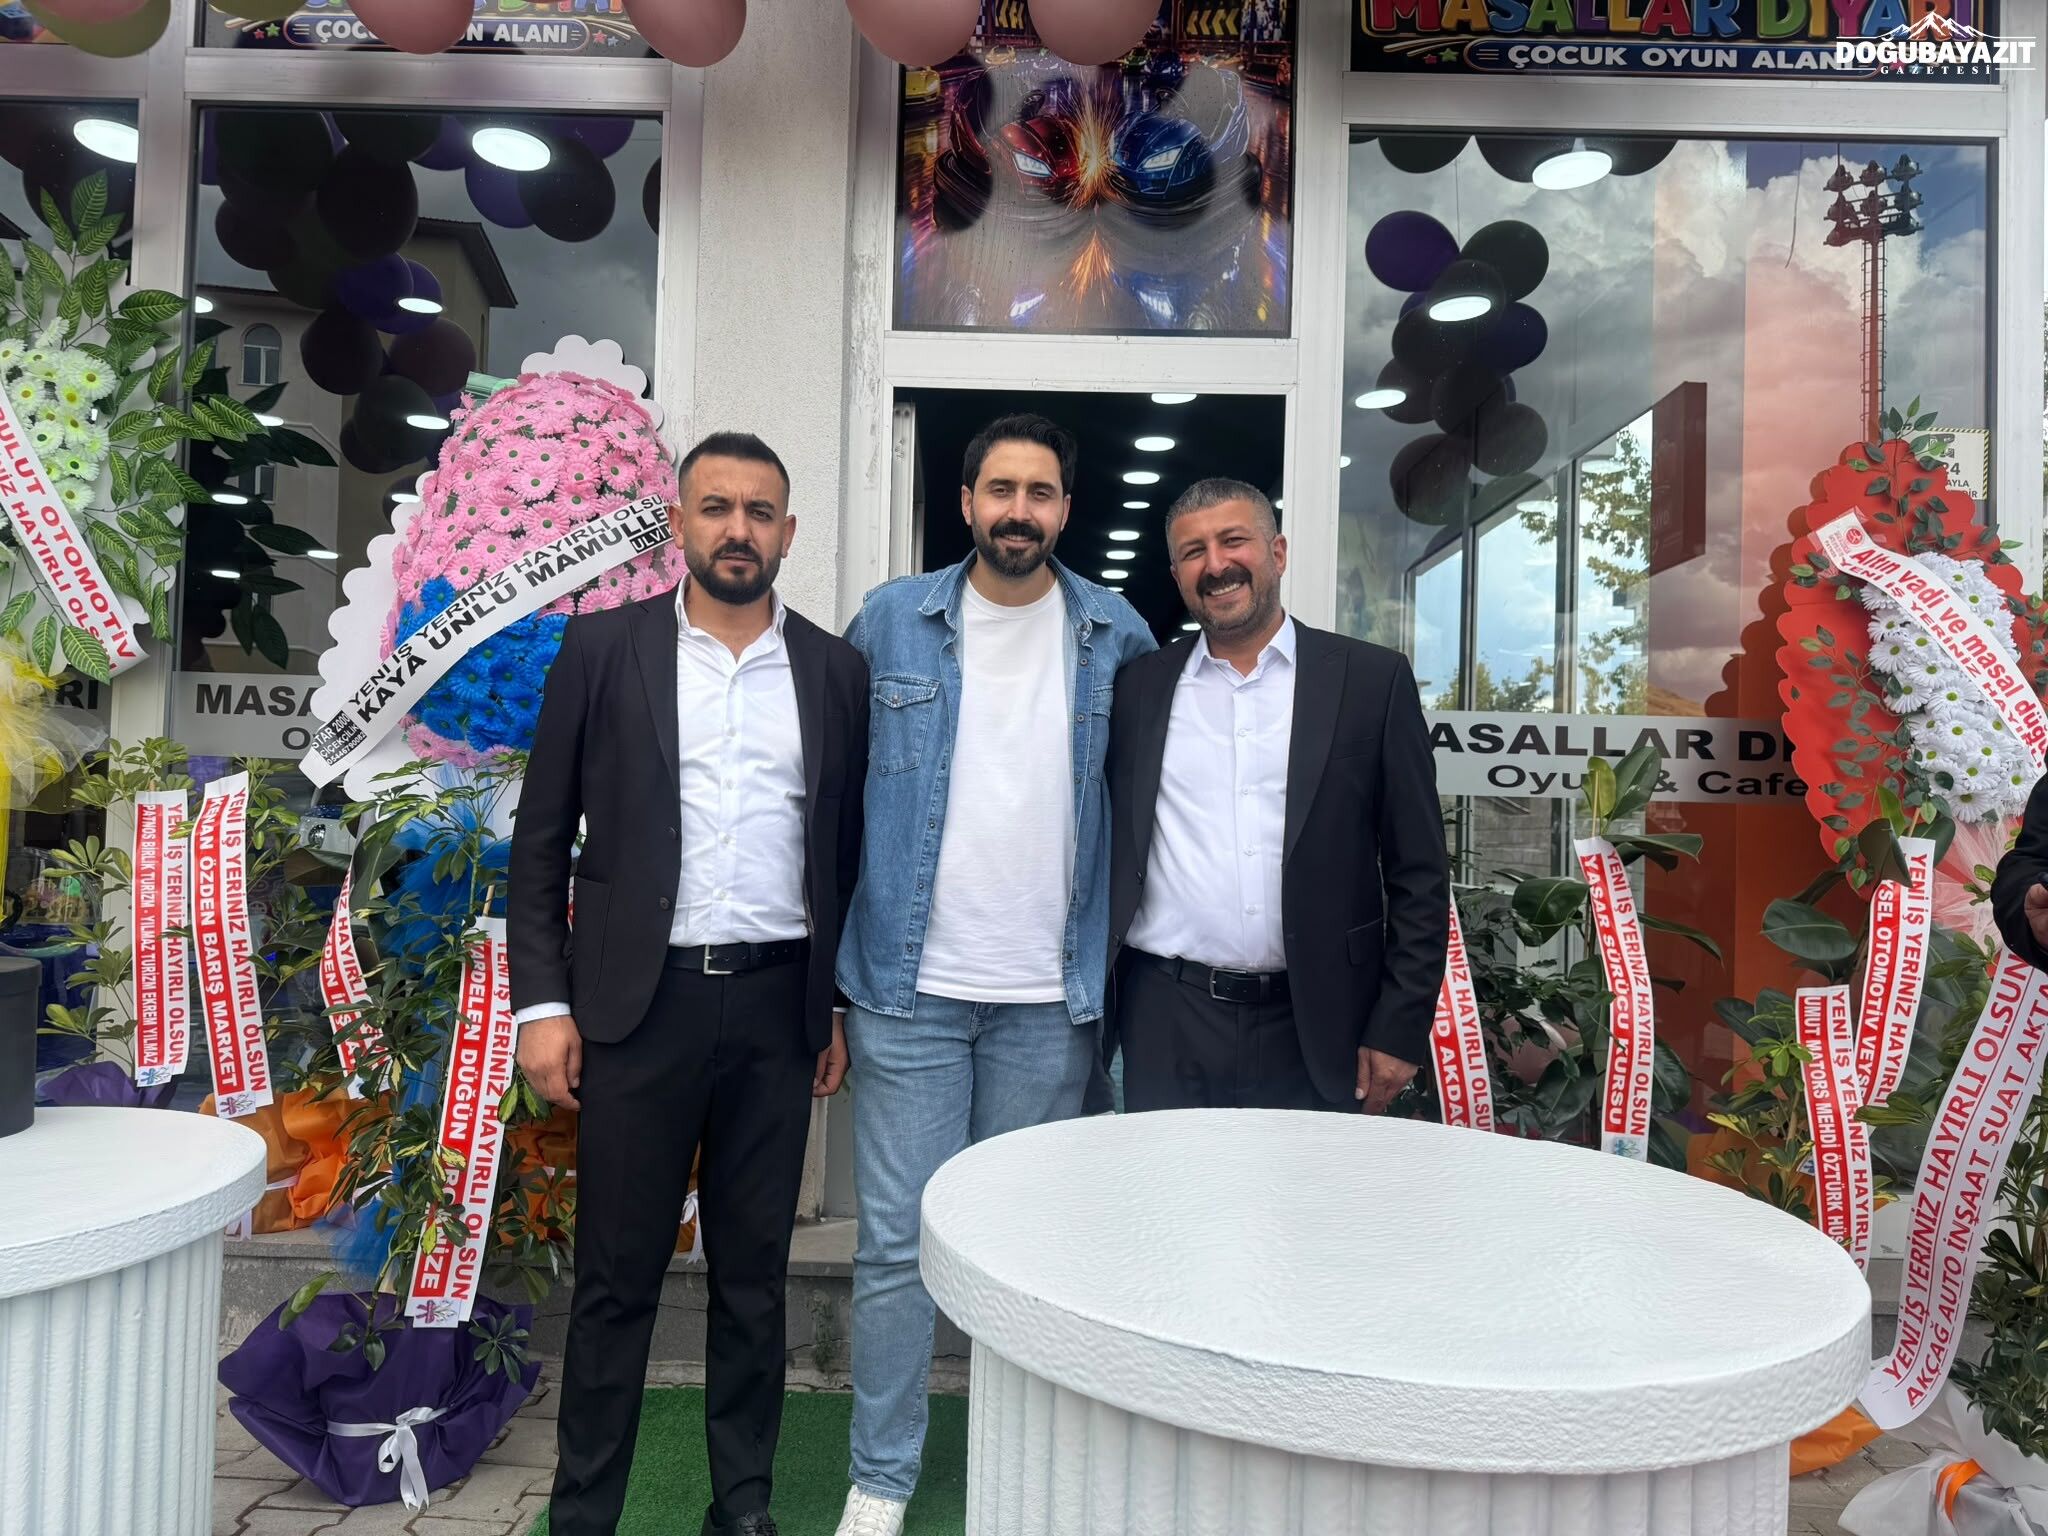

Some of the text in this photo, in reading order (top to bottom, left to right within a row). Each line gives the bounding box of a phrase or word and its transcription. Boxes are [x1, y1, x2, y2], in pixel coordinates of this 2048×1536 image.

[493, 24, 568, 43] ALANI
[1507, 45, 1626, 69] ÇOCUK
[1641, 48, 1738, 68] OYUN
[614, 494, 664, 521] OLSU
[11, 501, 72, 593] HAYIRLI
[40, 505, 137, 659] OTOMOTİV
[1939, 607, 1967, 634] ve
[1962, 634, 2024, 698] masal
[357, 655, 427, 723] KAYA
[312, 727, 336, 749] STAR
[332, 713, 351, 732] 2000
[1429, 722, 1715, 760] ASALLAR
[1487, 764, 1586, 794] Oyu
[1697, 770, 1809, 796] Cafe
[140, 804, 157, 839] PATNOS
[140, 841, 159, 870] BİRLİK
[140, 872, 159, 908] TURİZM
[140, 915, 157, 951] YILMAZ
[168, 934, 184, 1001] HAYIRLI
[199, 799, 238, 1087] KENAN ÖZDEN BARIŞ MARKET
[222, 787, 267, 1092] YENİ İŞ YERİNİZ HAYIRLI OLSUN
[338, 917, 367, 997] HAYIRLI
[141, 954, 159, 990] TURİZM
[1606, 851, 1651, 1136] YENİ İŞ YERİNİZ HAYIRLI OLSUN
[1865, 926, 1893, 1031] OTOMOTİV
[1874, 853, 1930, 1104] YENİ İŞ YERİNİZ HAYIRLI
[142, 992, 158, 1025] EKREM
[169, 1007, 185, 1064] OLSUN
[1448, 910, 1491, 1131] ERİNİZ HAYIRLI OLSU
[1804, 996, 1822, 1036] UMUT
[1832, 991, 1852, 1040] YENİ
[143, 1028, 159, 1066] YILMAZ
[486, 1008, 513, 1096] YERİNİZ
[1609, 1037, 1629, 1125] KURSU
[1833, 1048, 1853, 1068] İŞ
[449, 1049, 477, 1140] DÜĞÜN
[1815, 1103, 1842, 1148] MEHDİ
[1978, 1065, 2025, 1146] SUAT
[469, 1104, 498, 1205] HAYIRLI
[1822, 1152, 1845, 1212] ÖZTÜRK
[1883, 954, 2029, 1382] YENİ İŞ YERİNİZ HAYIRLI OLSUN
[1854, 1169, 1869, 1252] HAYIRLI
[1943, 1149, 1992, 1254] İNŞAAT
[451, 1213, 484, 1300] OLSUN
[1938, 1255, 1962, 1325] AUTO
[1907, 1320, 1950, 1408] AKÇAĞ
